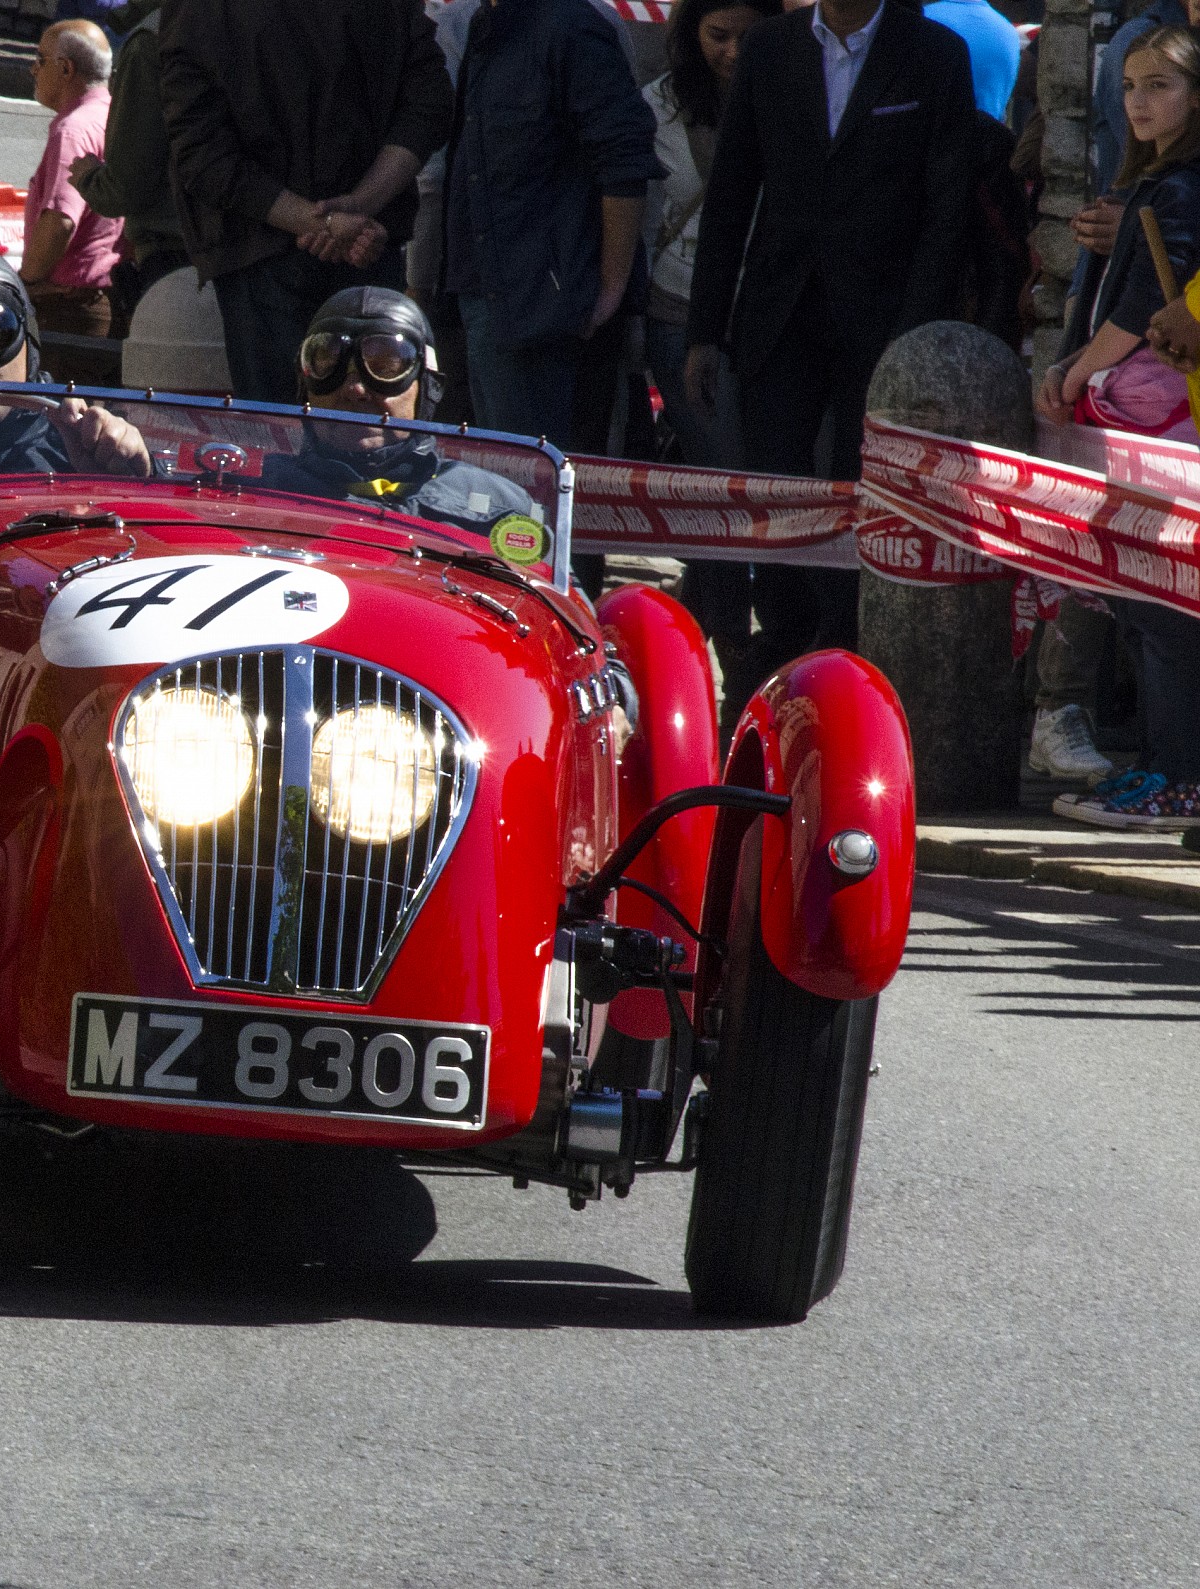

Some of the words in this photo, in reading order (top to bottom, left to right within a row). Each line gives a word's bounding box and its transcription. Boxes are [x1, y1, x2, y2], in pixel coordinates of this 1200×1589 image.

[75, 565, 292, 630] 41
[84, 1009, 203, 1091] MZ
[234, 1022, 473, 1113] 8306
